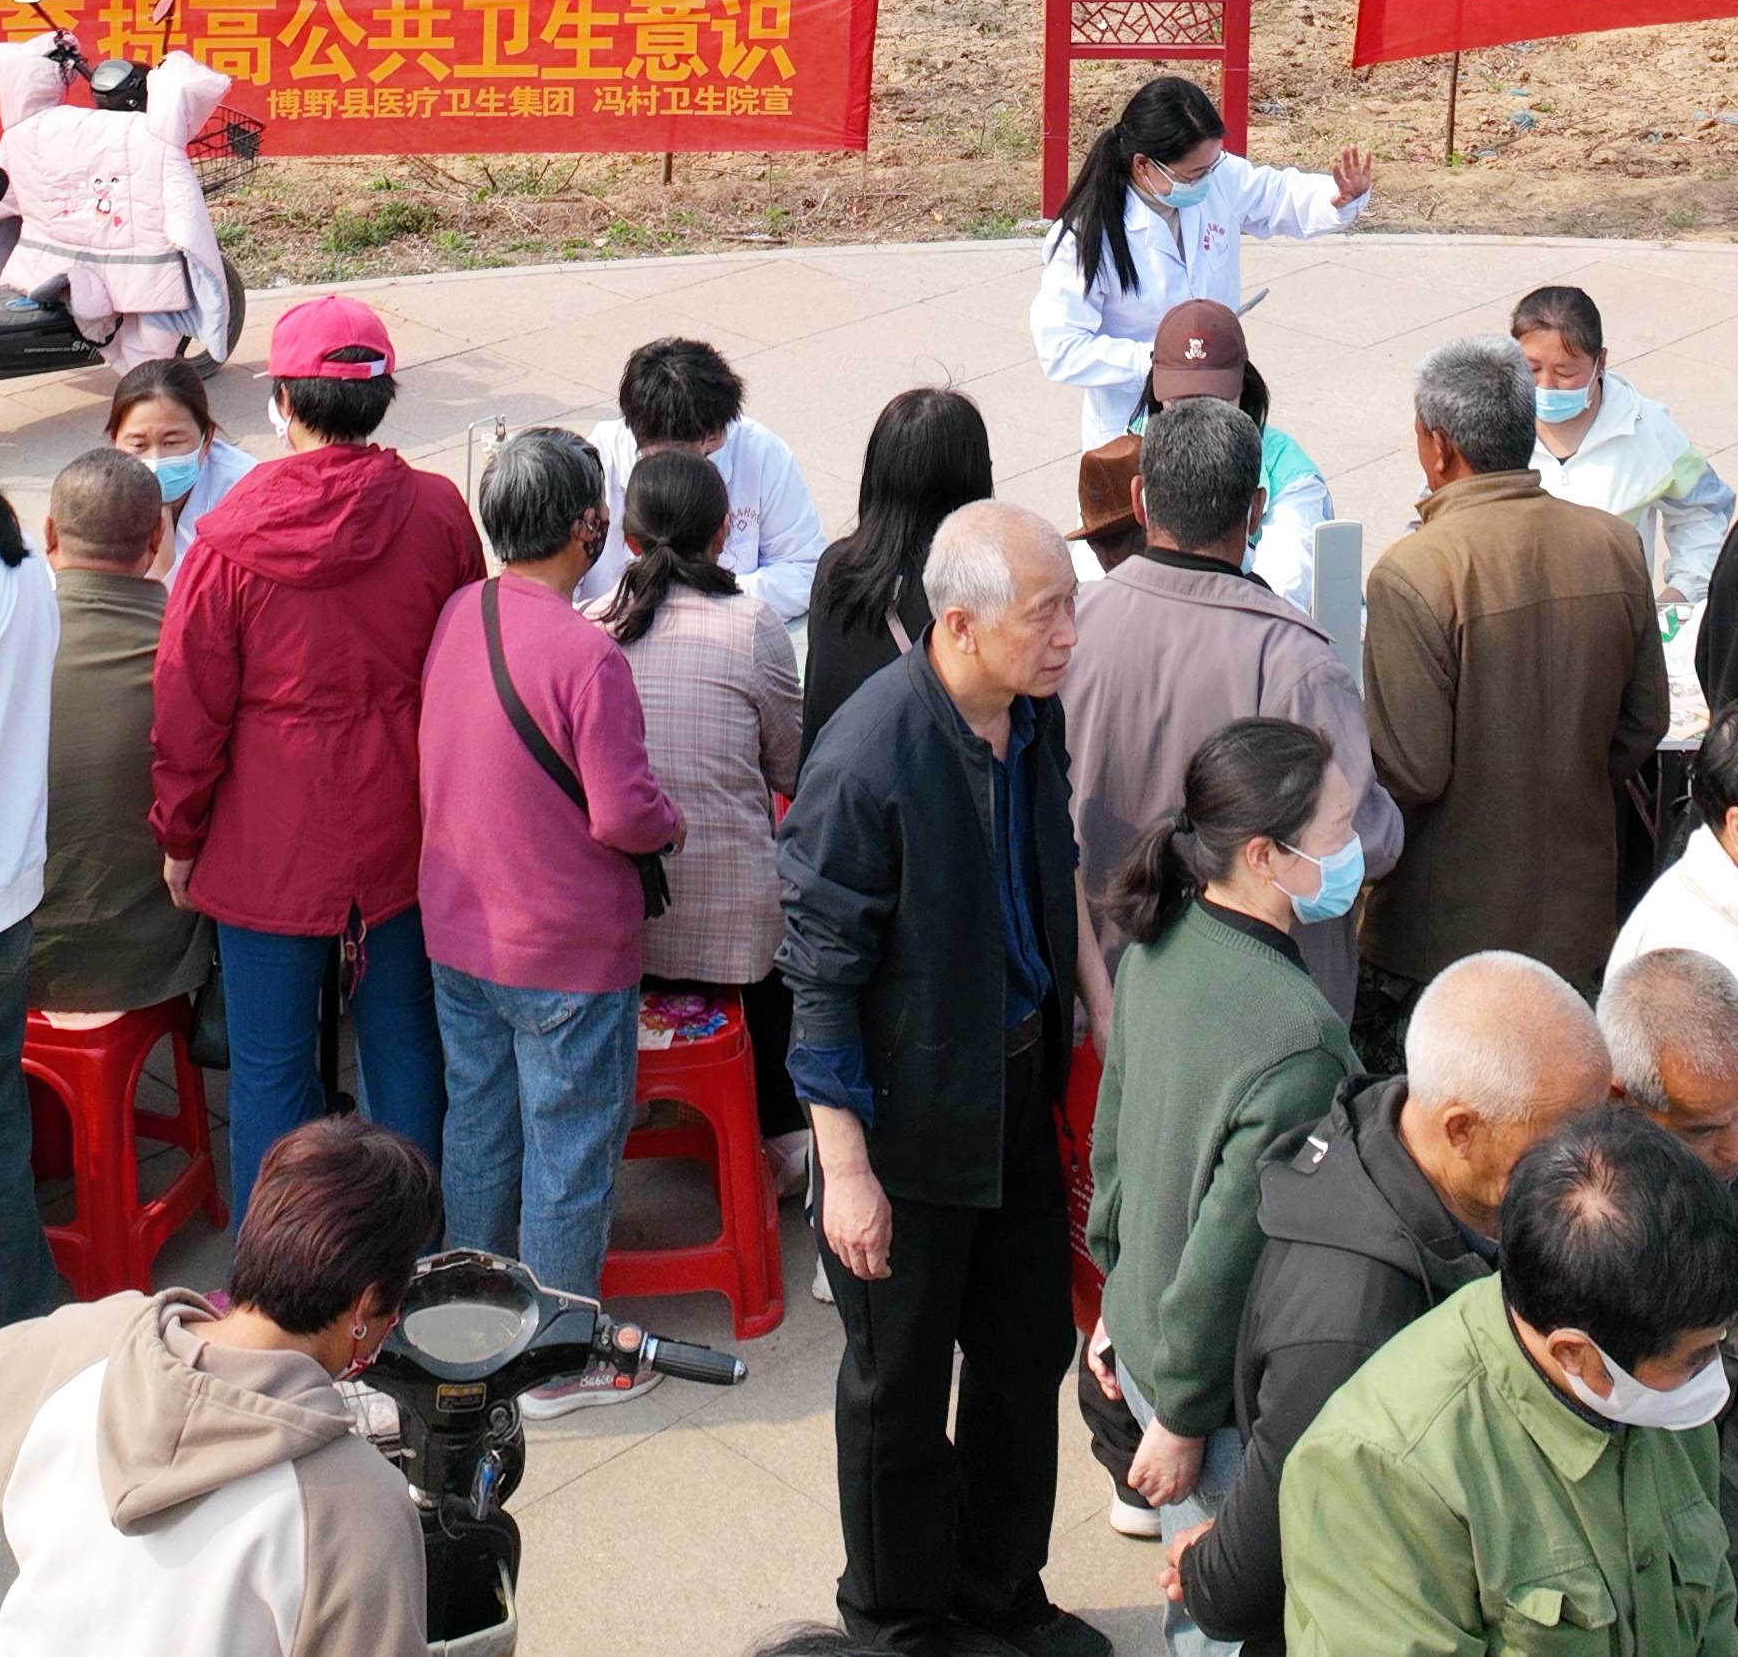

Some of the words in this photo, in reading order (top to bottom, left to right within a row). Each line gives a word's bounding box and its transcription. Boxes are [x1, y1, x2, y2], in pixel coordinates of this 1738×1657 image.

[266, 84, 575, 121] 博野县医疗卫生集团
[592, 85, 793, 117] 冯村卫生院宣
